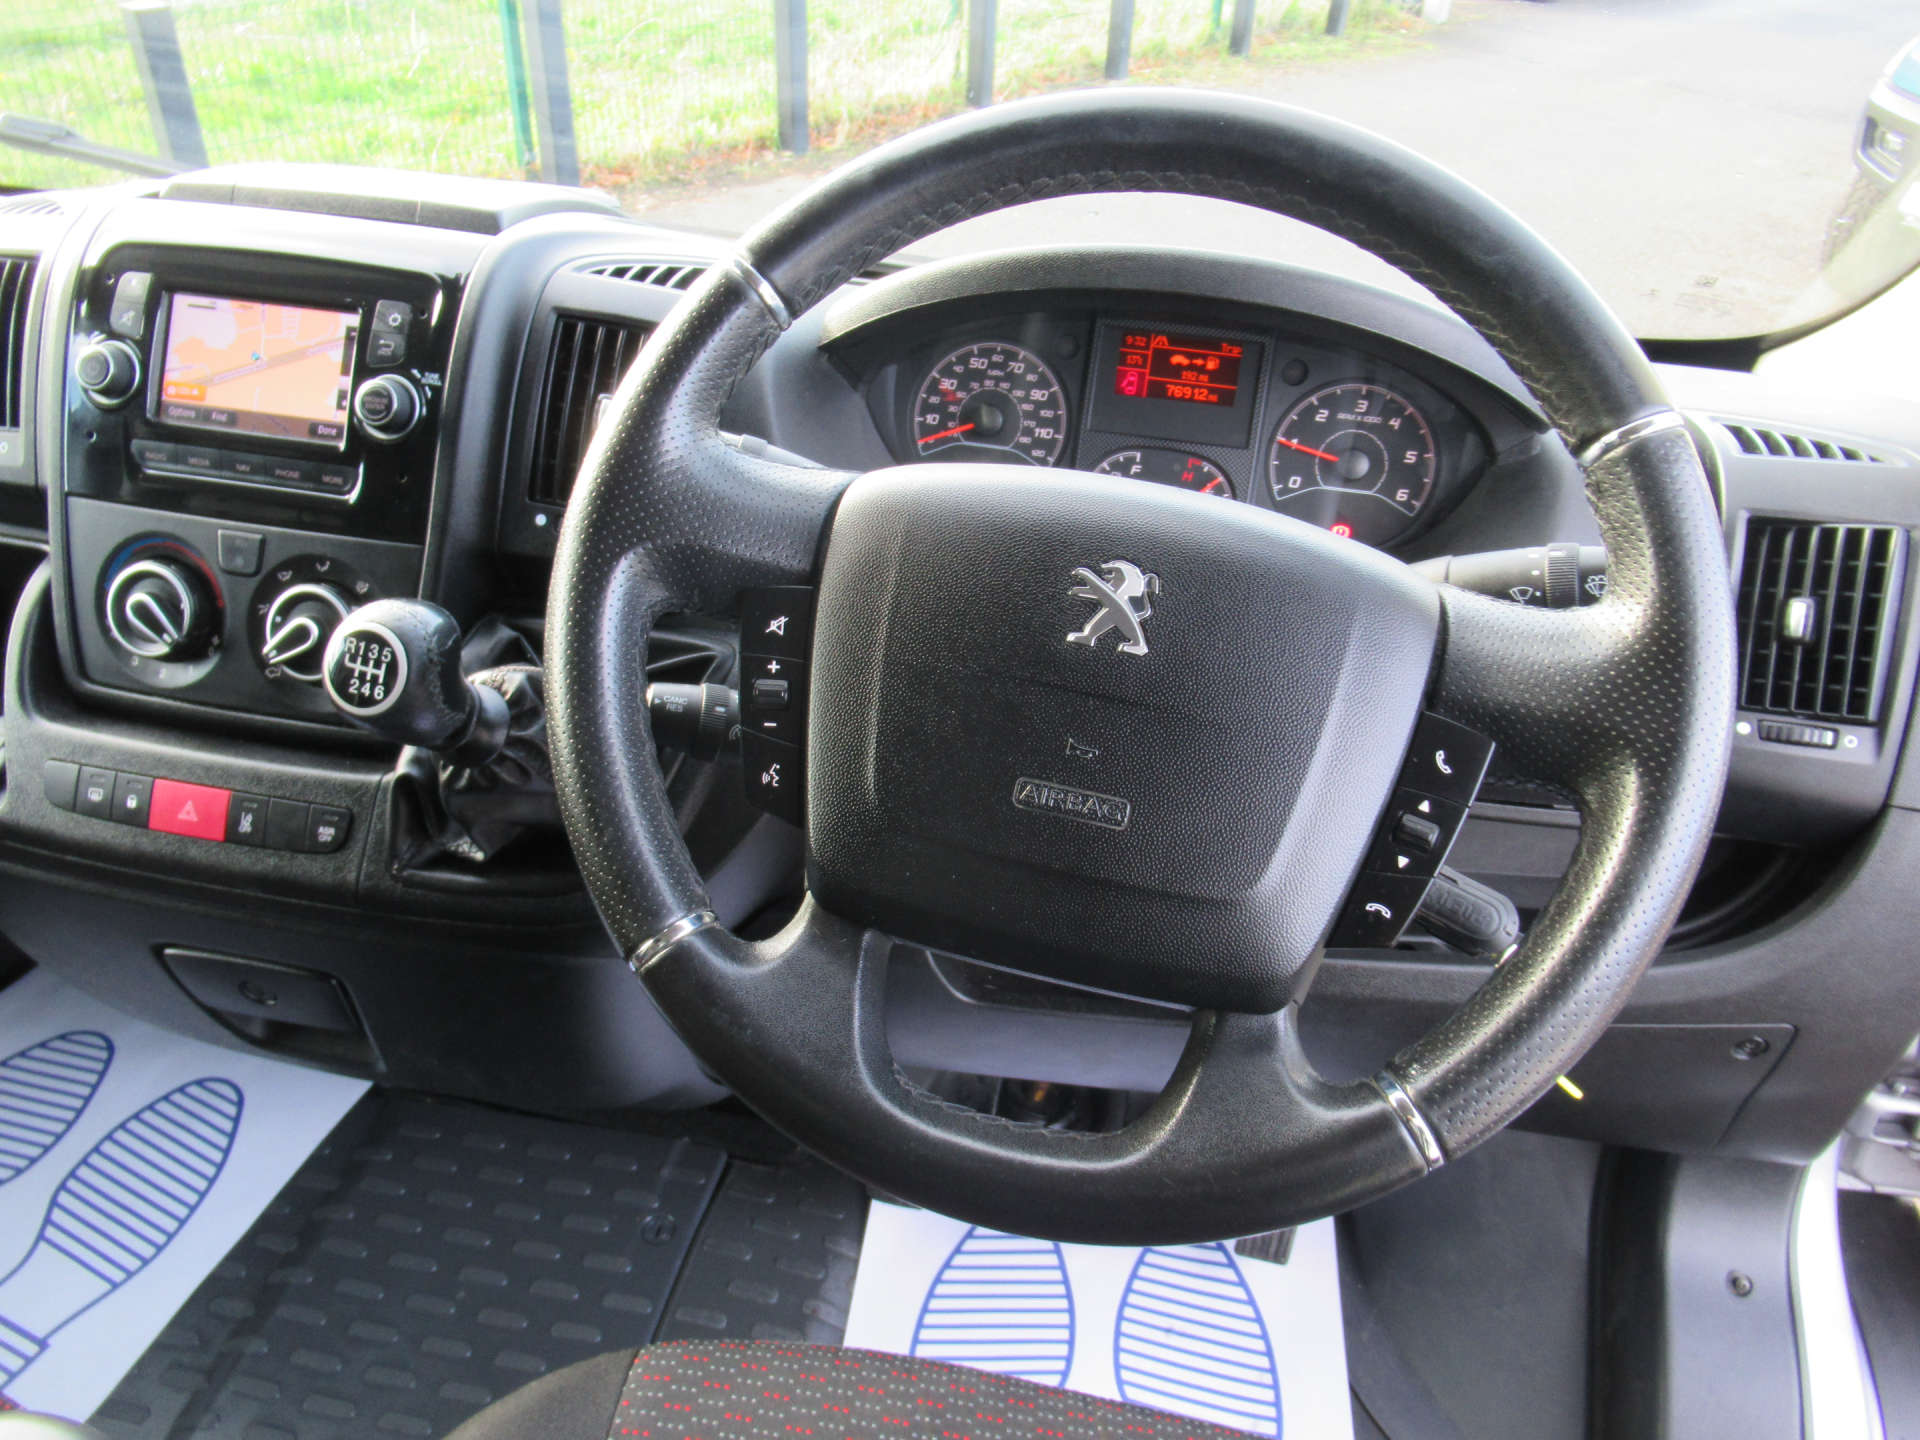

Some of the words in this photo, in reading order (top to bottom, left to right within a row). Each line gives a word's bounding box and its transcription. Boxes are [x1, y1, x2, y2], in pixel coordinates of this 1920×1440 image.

[968, 358, 988, 369] 50
[1006, 362, 1024, 373] 70
[938, 378, 958, 390] 30
[1029, 389, 1049, 401] 90
[1354, 400, 1369, 413] 3
[168, 406, 197, 420] Options
[211, 410, 229, 423] Find
[925, 414, 940, 425] 10
[1040, 409, 1055, 418] 100
[1315, 409, 1330, 422] 2
[1388, 417, 1402, 430] 4
[317, 425, 338, 437] Done
[1034, 428, 1054, 439] 110
[1403, 451, 1418, 464] 5
[235, 463, 251, 473] NAV
[274, 468, 300, 480] PHONE
[1130, 465, 1143, 475] F
[322, 475, 345, 486] MORE
[1181, 470, 1195, 482] H
[1288, 476, 1302, 488] 0
[1395, 489, 1410, 501] 6
[344, 637, 357, 653] R
[358, 641, 366, 655] 1
[368, 643, 380, 659] 3
[381, 647, 393, 662] 5
[348, 678, 360, 694] 2
[360, 682, 371, 696] 4
[373, 685, 385, 700] 6
[1018, 783, 1123, 821] AIRBAG
